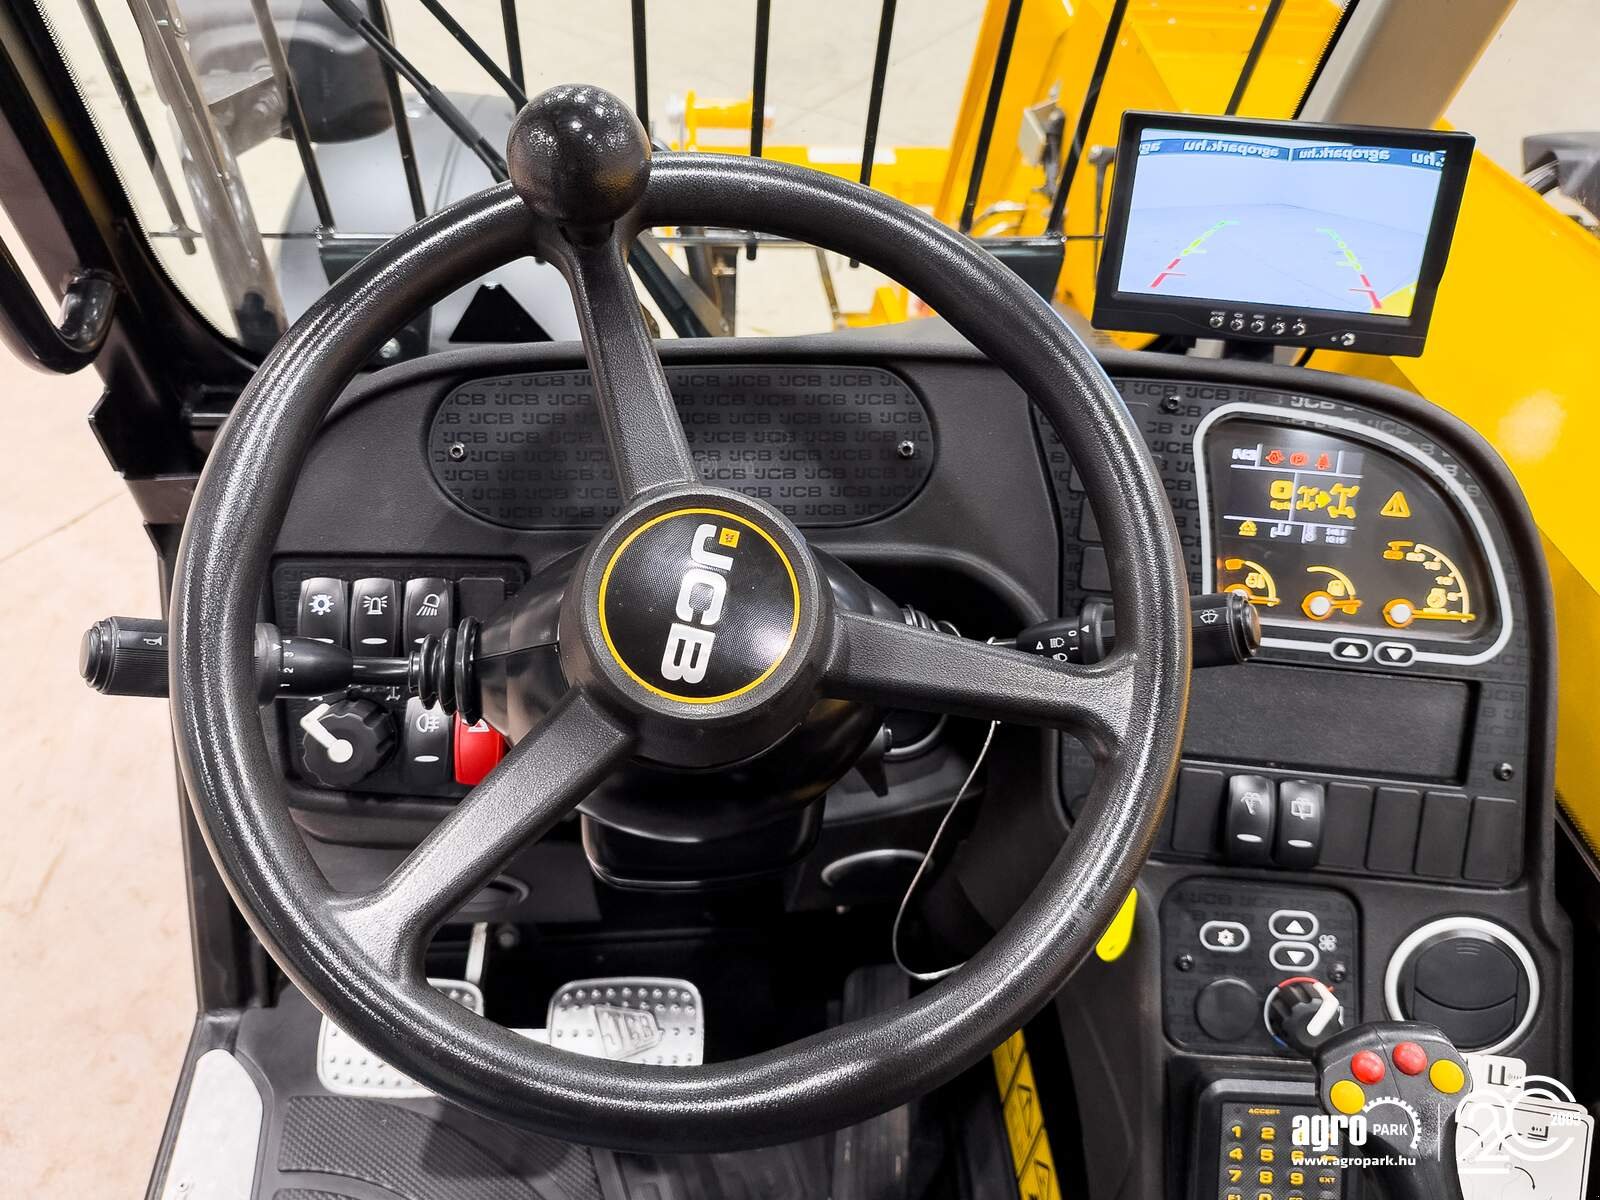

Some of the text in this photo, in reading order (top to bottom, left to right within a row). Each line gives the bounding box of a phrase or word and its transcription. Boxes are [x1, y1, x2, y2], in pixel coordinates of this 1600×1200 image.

[661, 523, 740, 684] JCB
[1231, 1124, 1276, 1142] 1 2
[1229, 1147, 1244, 1162] 4
[1260, 1148, 1275, 1163] 5
[1228, 1168, 1243, 1183] 7
[1259, 1171, 1274, 1185] 8
[1290, 1171, 1304, 1185] 9
